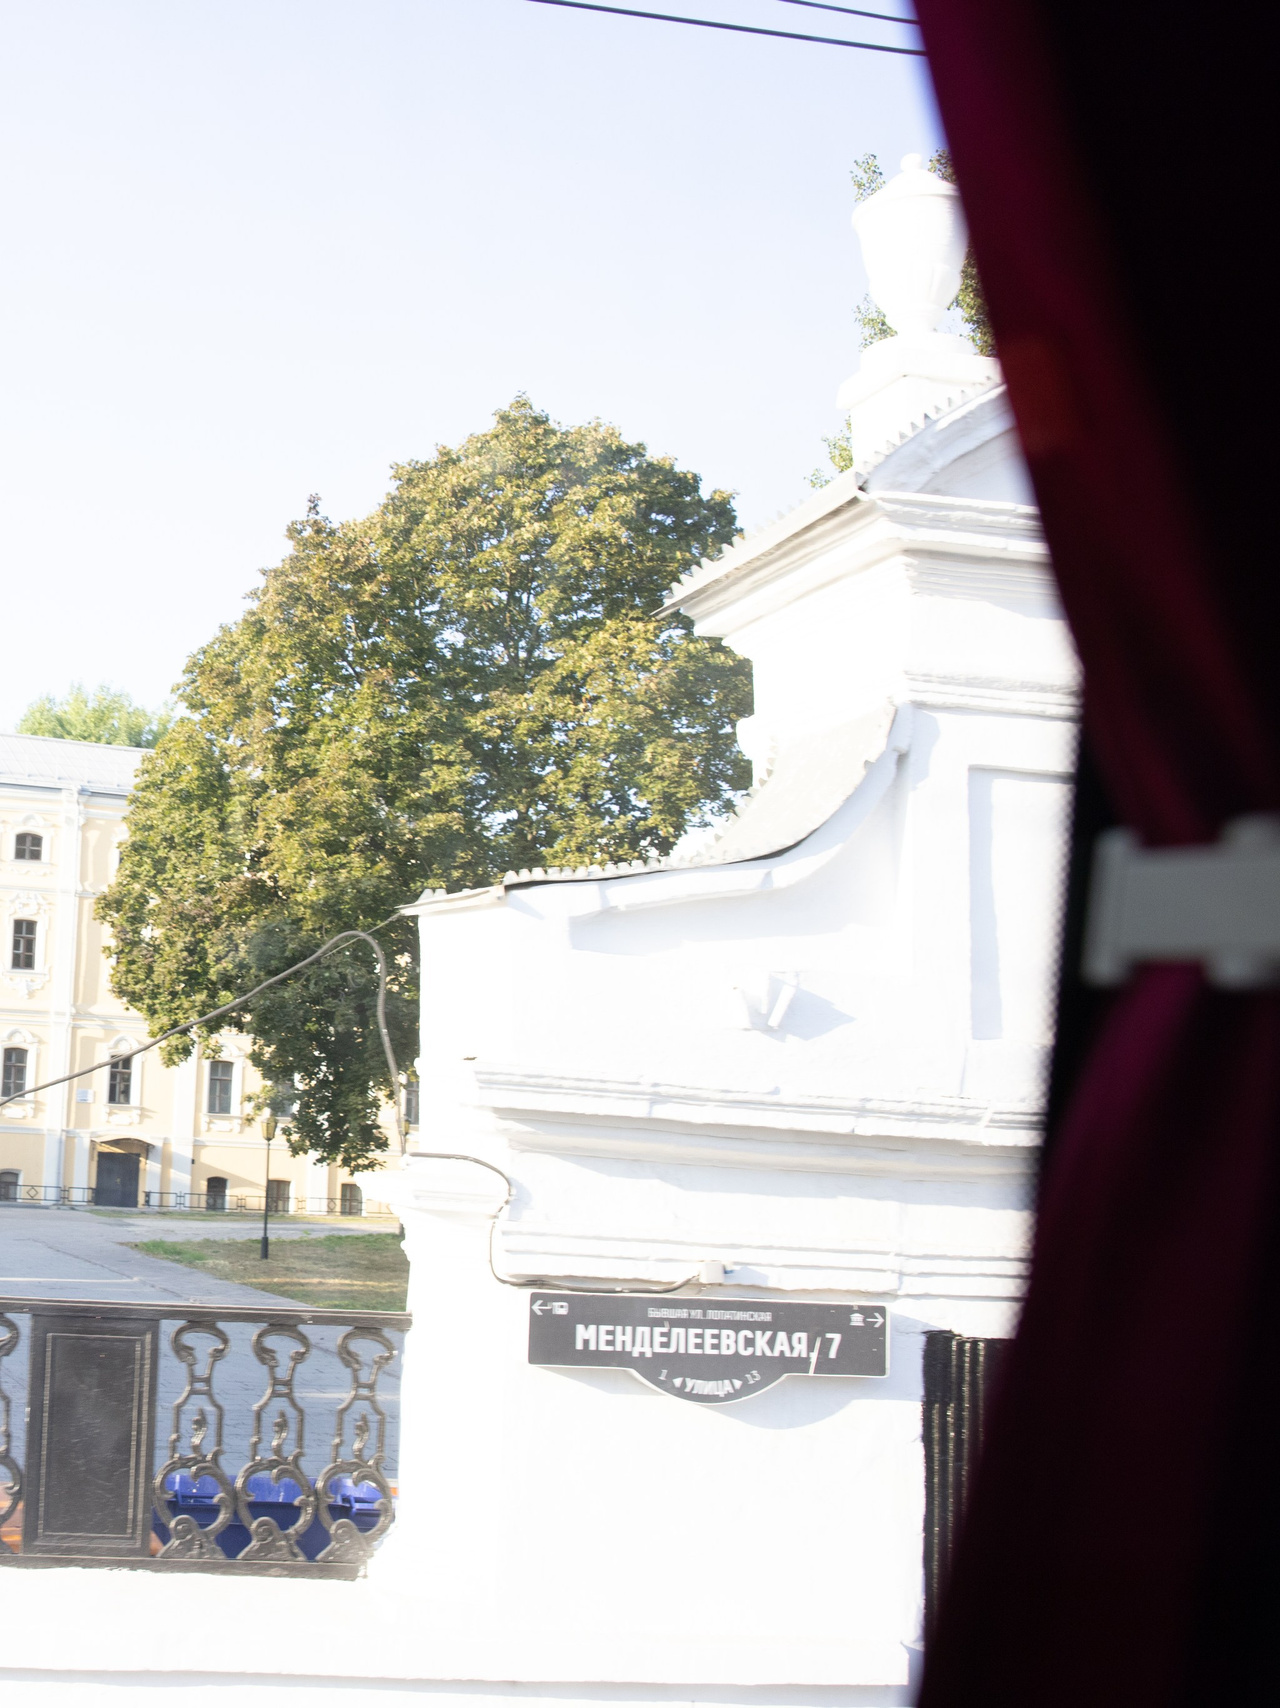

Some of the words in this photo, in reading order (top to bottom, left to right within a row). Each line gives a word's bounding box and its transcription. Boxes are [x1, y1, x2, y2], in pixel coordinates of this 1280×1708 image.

[648, 1307, 689, 1319] БЫВШАЯ
[825, 1333, 842, 1359] 7
[684, 1377, 735, 1397] УЛИЦА
